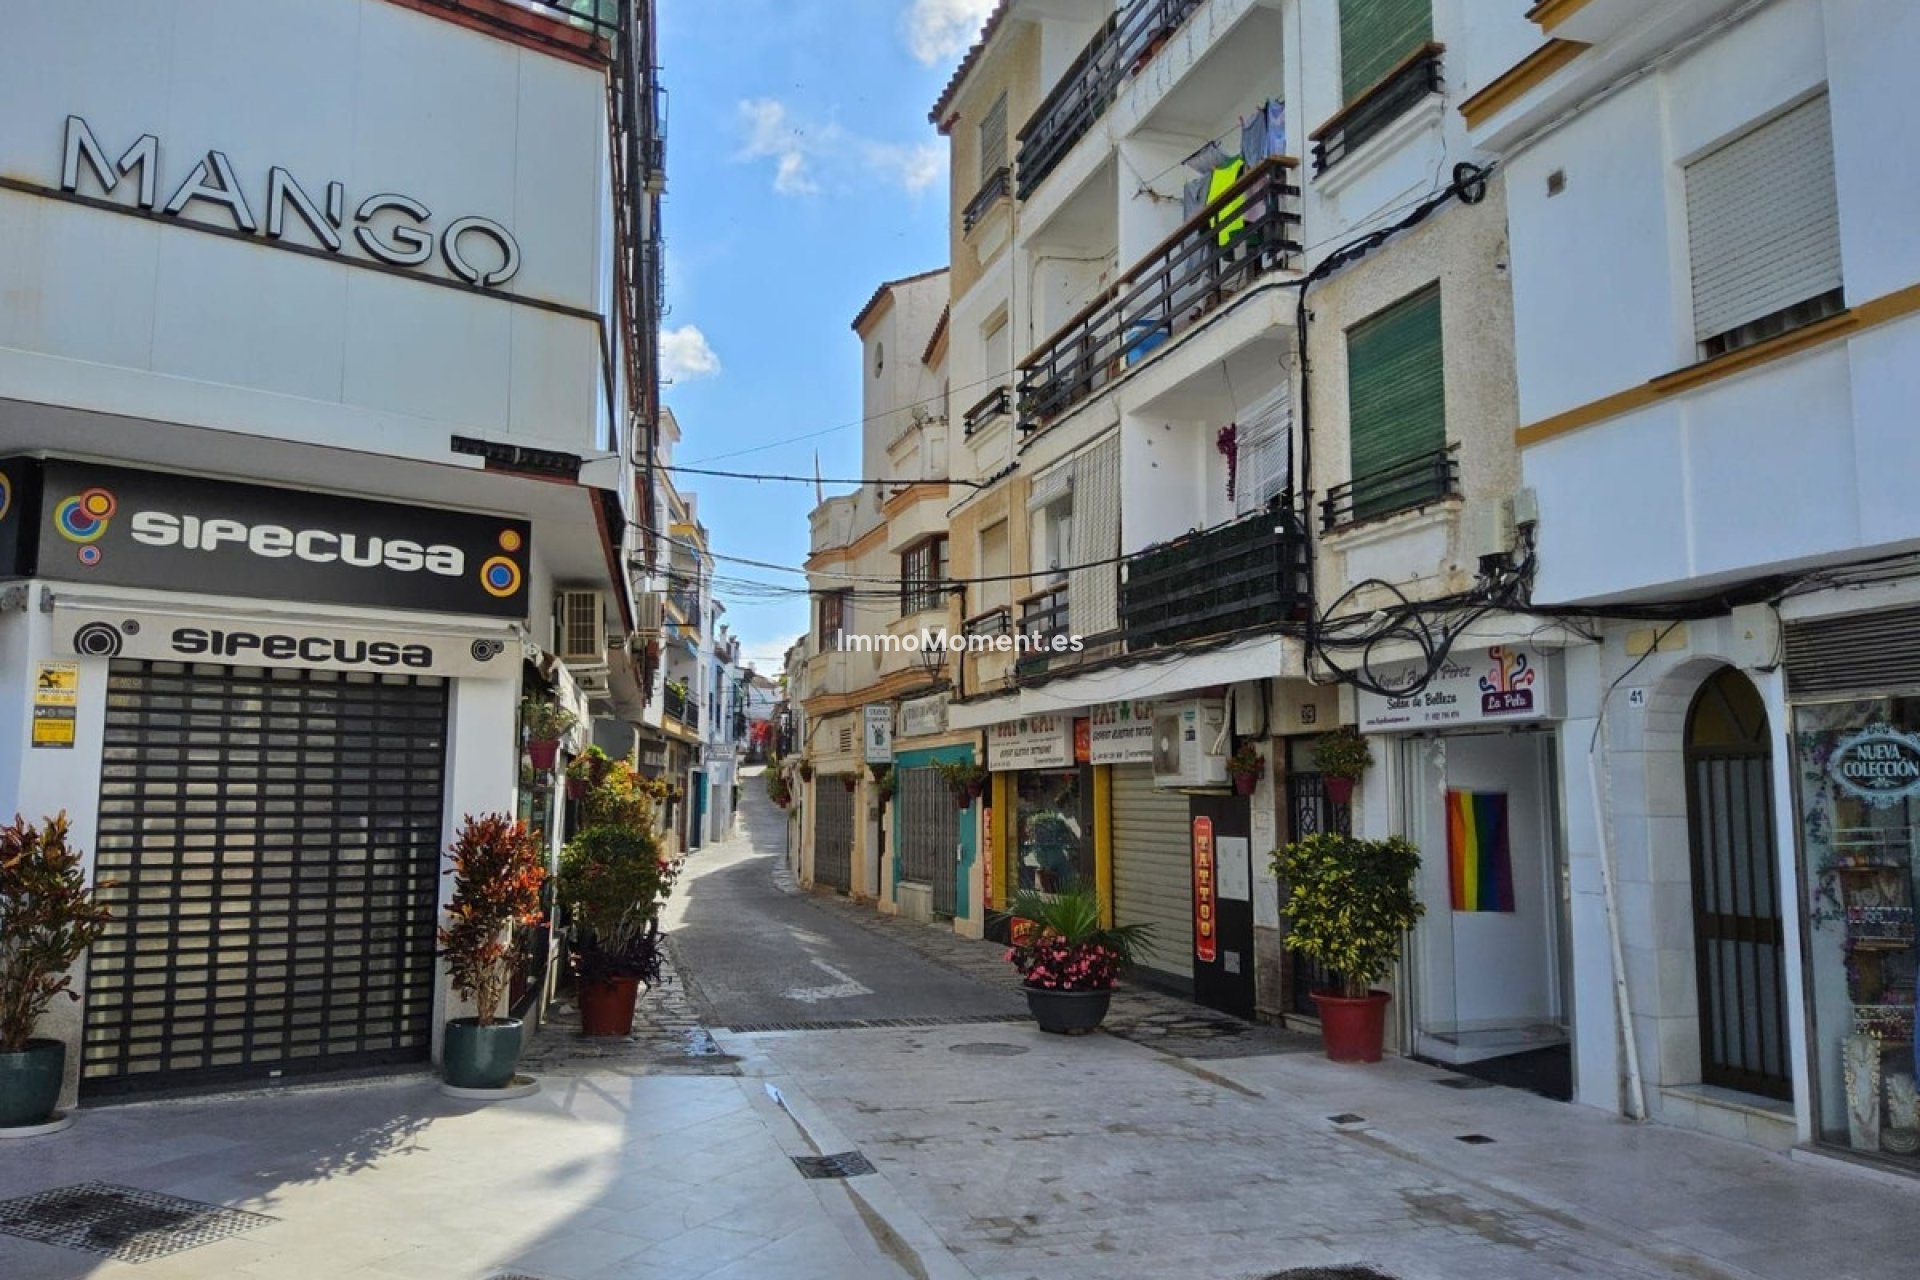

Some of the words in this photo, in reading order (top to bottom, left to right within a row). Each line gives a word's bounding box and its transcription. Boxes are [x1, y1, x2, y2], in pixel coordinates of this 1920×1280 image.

[61, 114, 521, 286] MANGO
[1630, 689, 1643, 704] 41
[1857, 744, 1901, 760] NUEVA
[1844, 758, 1919, 777] COLECCIÓN
